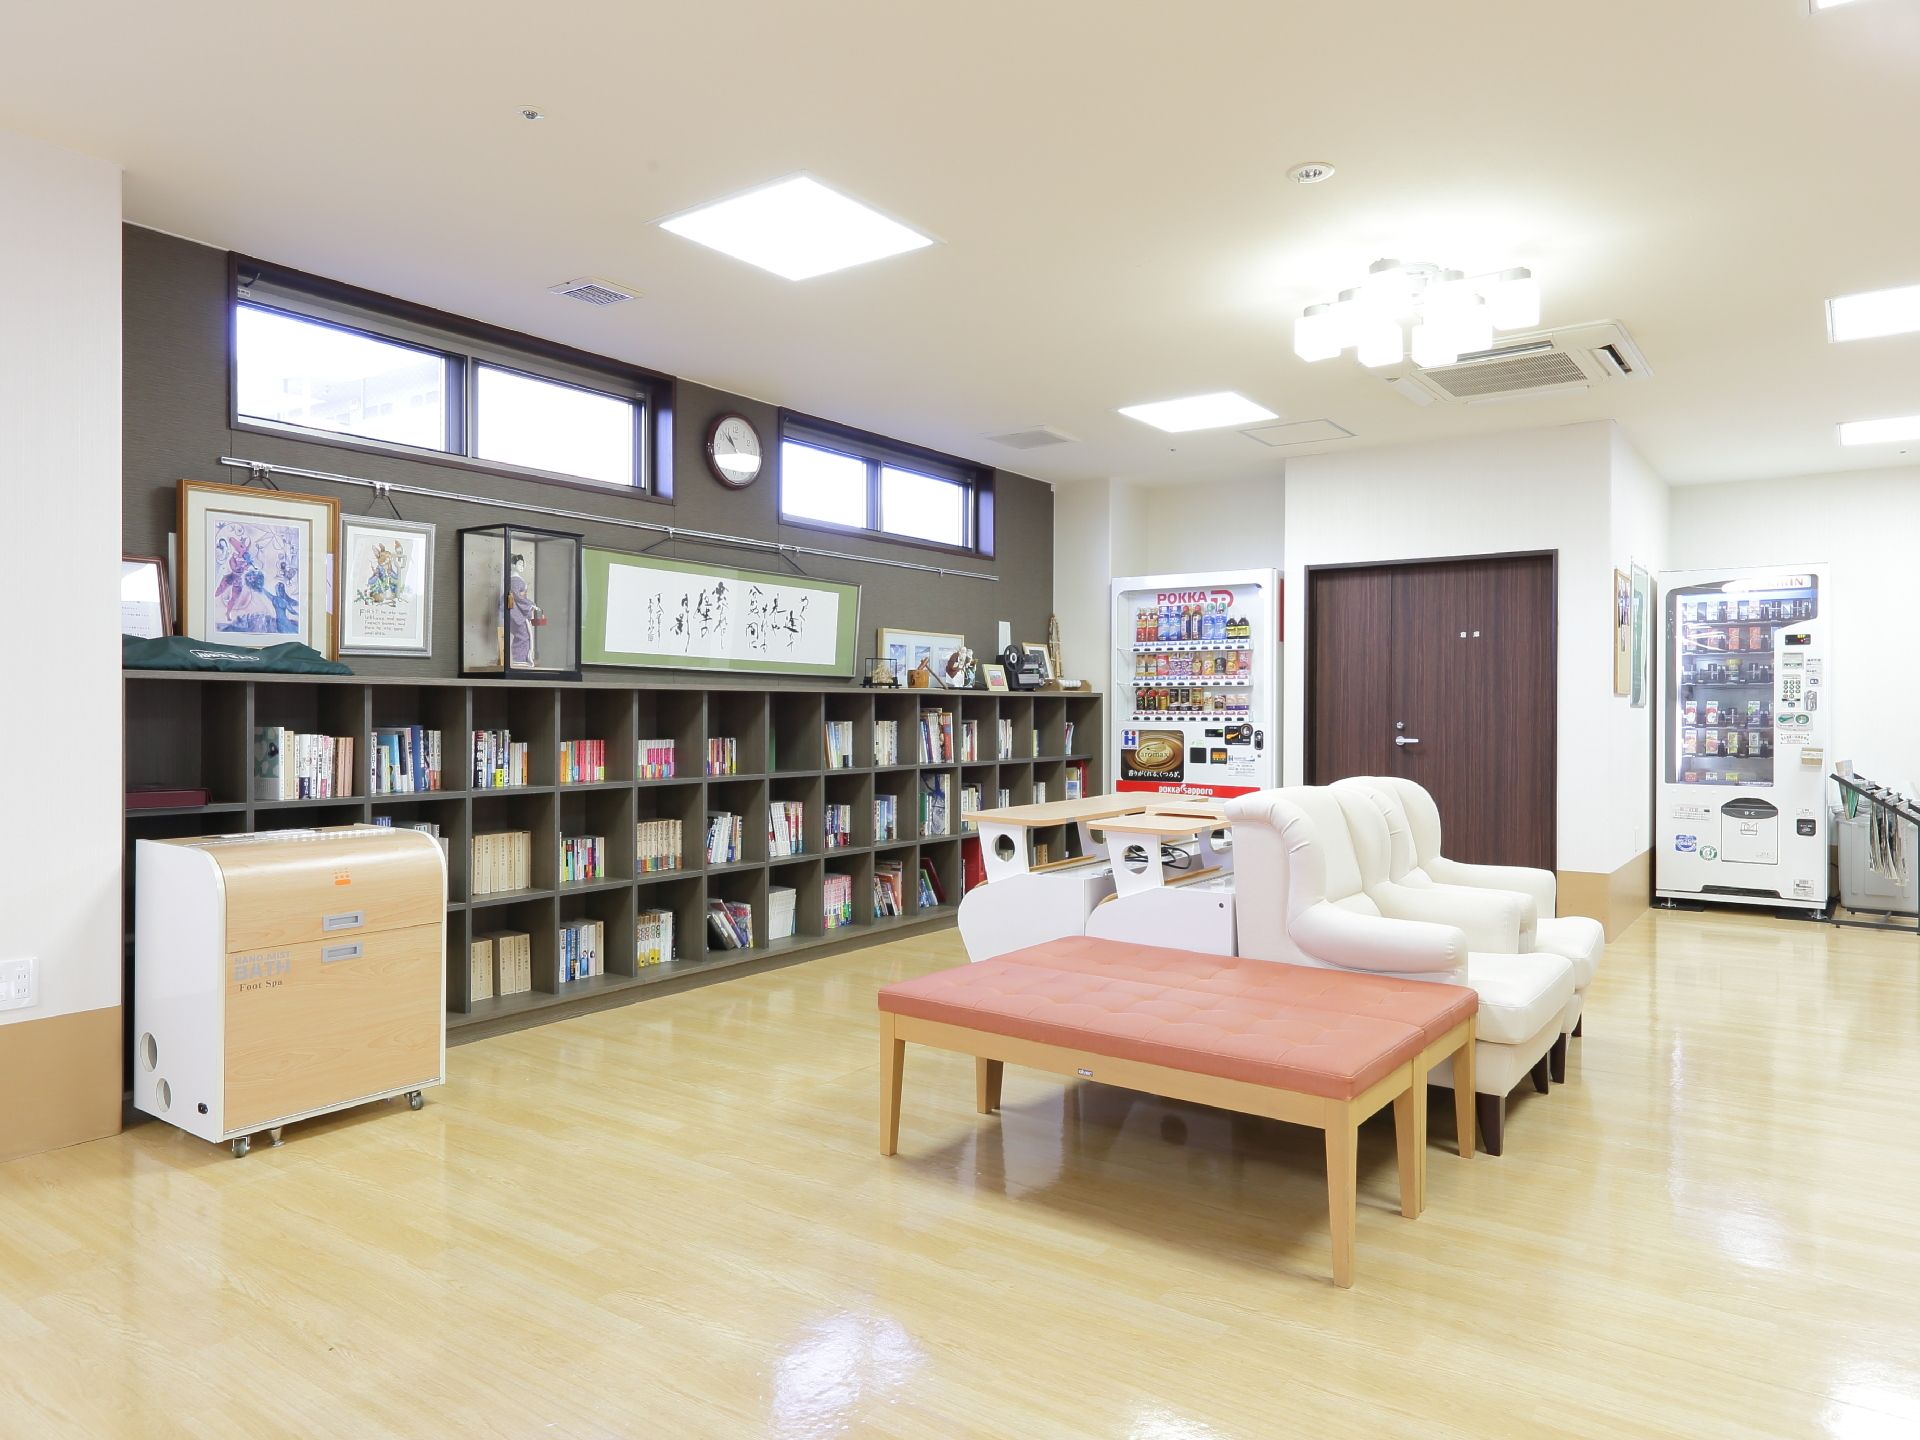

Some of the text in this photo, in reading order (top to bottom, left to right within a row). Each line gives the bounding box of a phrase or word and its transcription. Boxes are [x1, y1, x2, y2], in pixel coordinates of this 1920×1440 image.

[1157, 591, 1208, 605] POKKA
[1140, 750, 1169, 758] aromax
[240, 980, 283, 992] Foot Spa
